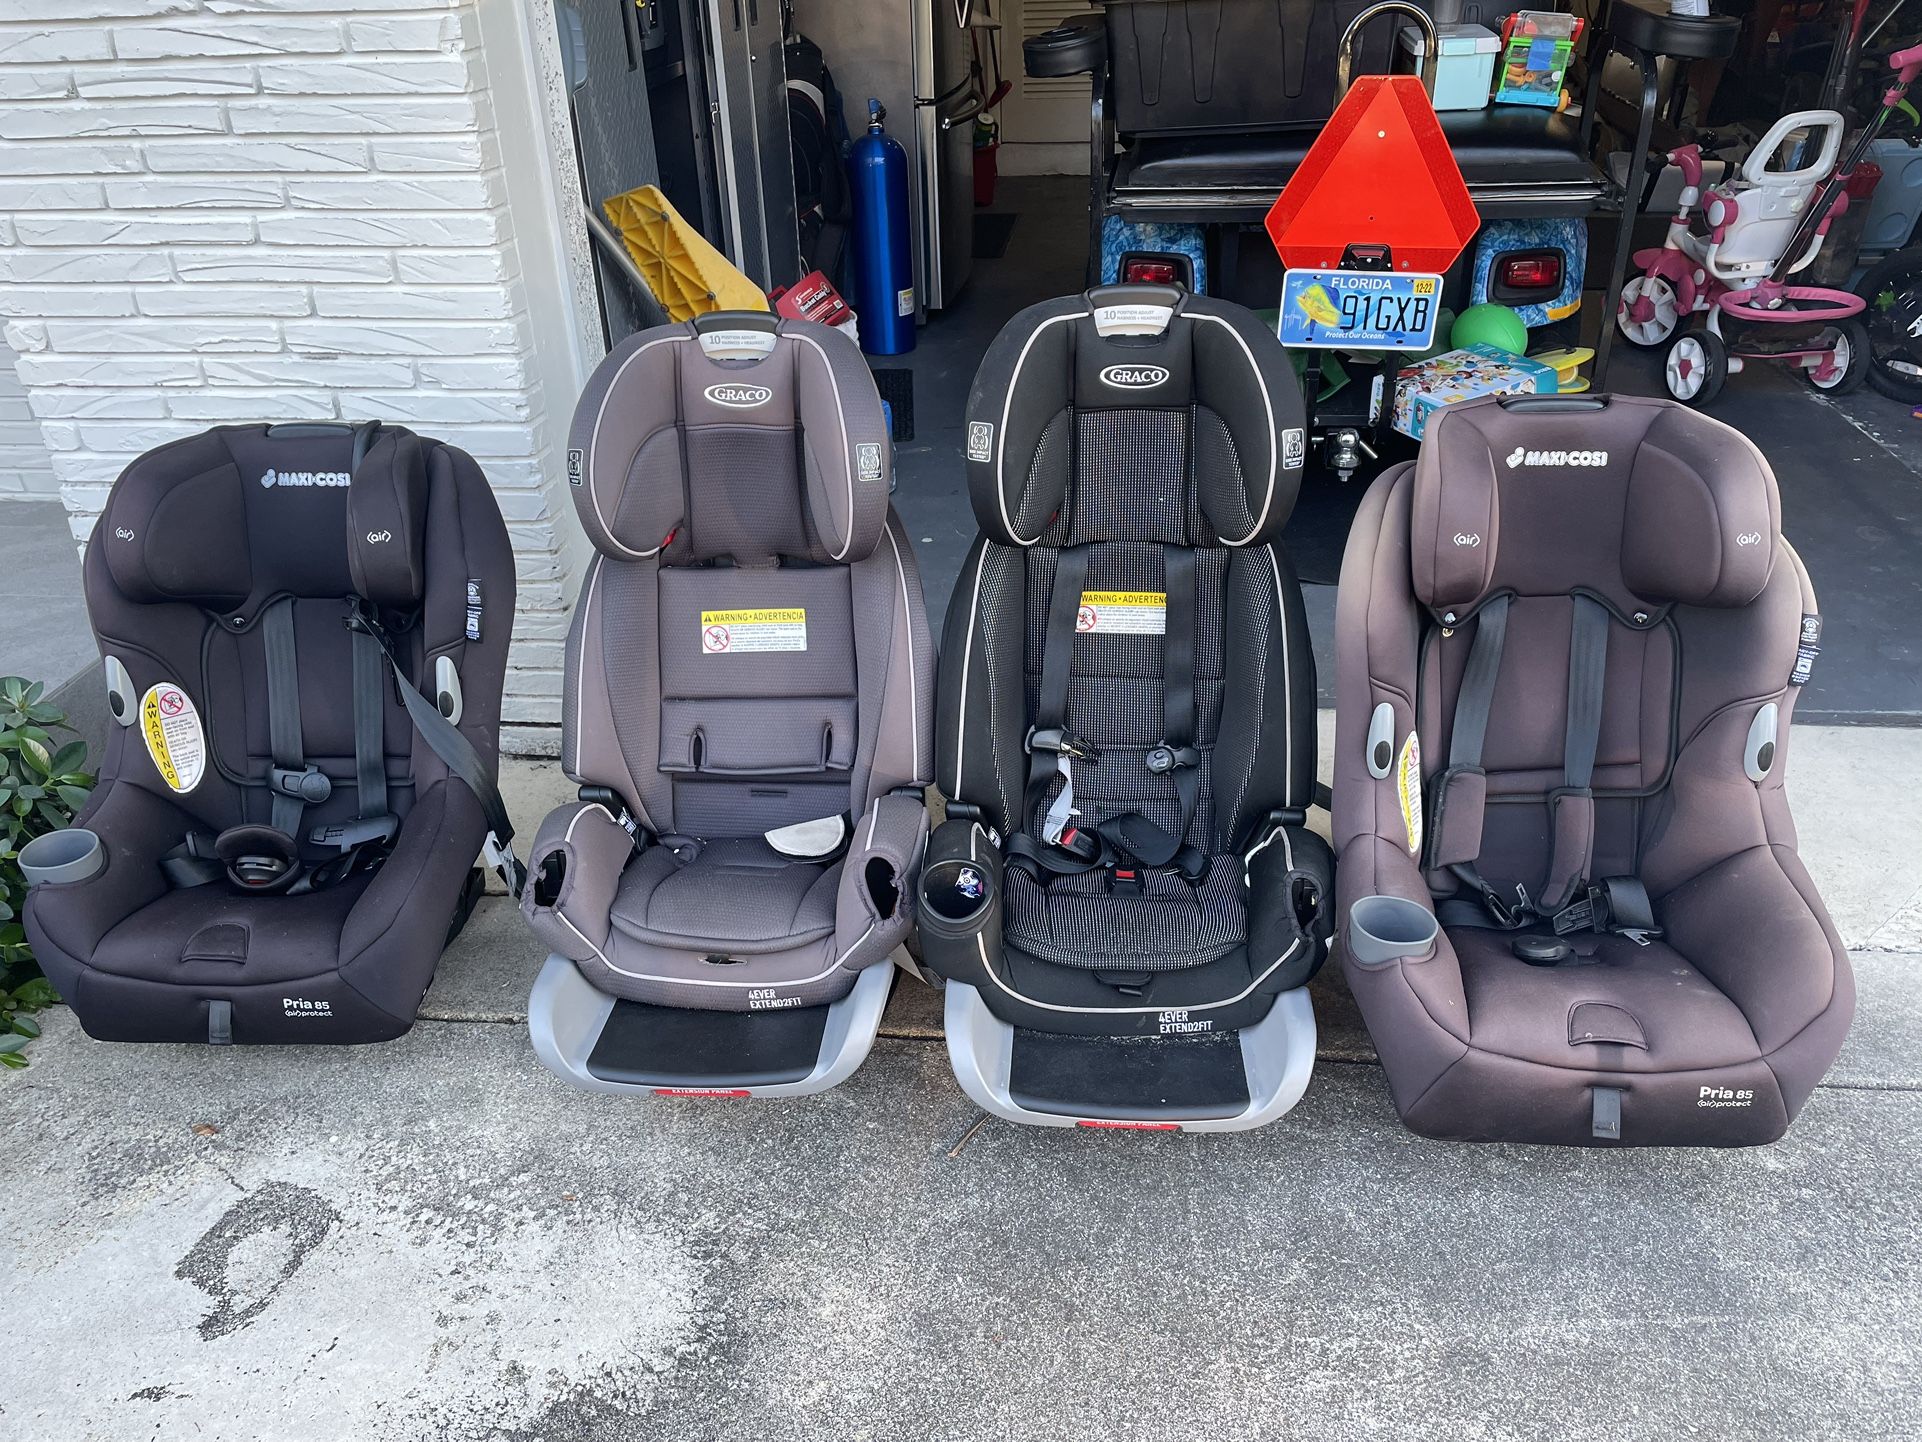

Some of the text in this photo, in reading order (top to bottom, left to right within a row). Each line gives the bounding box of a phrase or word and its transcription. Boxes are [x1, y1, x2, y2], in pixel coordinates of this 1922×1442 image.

[1331, 277, 1392, 290] FLORIDA
[1415, 282, 1432, 293] 12-22
[1104, 310, 1117, 320] 10
[1339, 295, 1430, 332] 91GXB
[709, 335, 721, 345] 10
[1325, 331, 1385, 340] Protect Our Oceans
[1110, 369, 1163, 383] GRACO
[714, 388, 767, 401] GRACO
[1081, 595, 1117, 603] WARNING
[713, 612, 804, 622] WARNING ADVERTENCIA
[147, 710, 175, 780] WARNING
[749, 989, 776, 999] 4EVER
[283, 998, 330, 1009] Pria 85
[750, 997, 801, 1009] EXTEND2FIT
[1159, 1010, 1188, 1023] 4EVER
[1160, 1020, 1213, 1034] EXTEND2FIT
[1700, 1086, 1754, 1099] Pria 85
